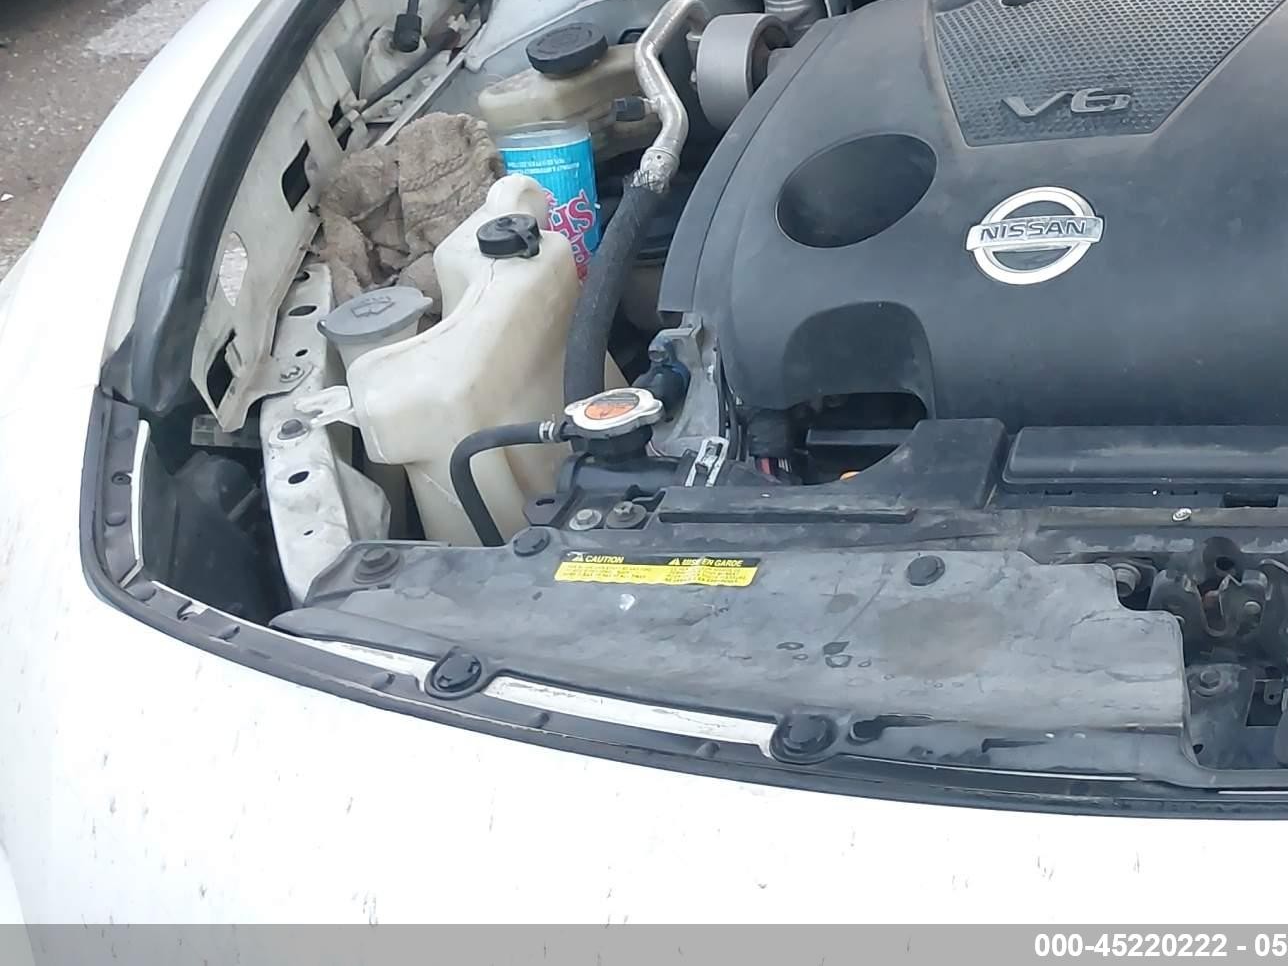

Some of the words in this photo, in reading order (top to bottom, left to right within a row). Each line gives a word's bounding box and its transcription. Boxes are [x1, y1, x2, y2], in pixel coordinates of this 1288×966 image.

[1001, 88, 1131, 117] V6
[980, 220, 1087, 241] NISSAN
[585, 555, 624, 564] CAUTION
[714, 559, 744, 567] GARDE
